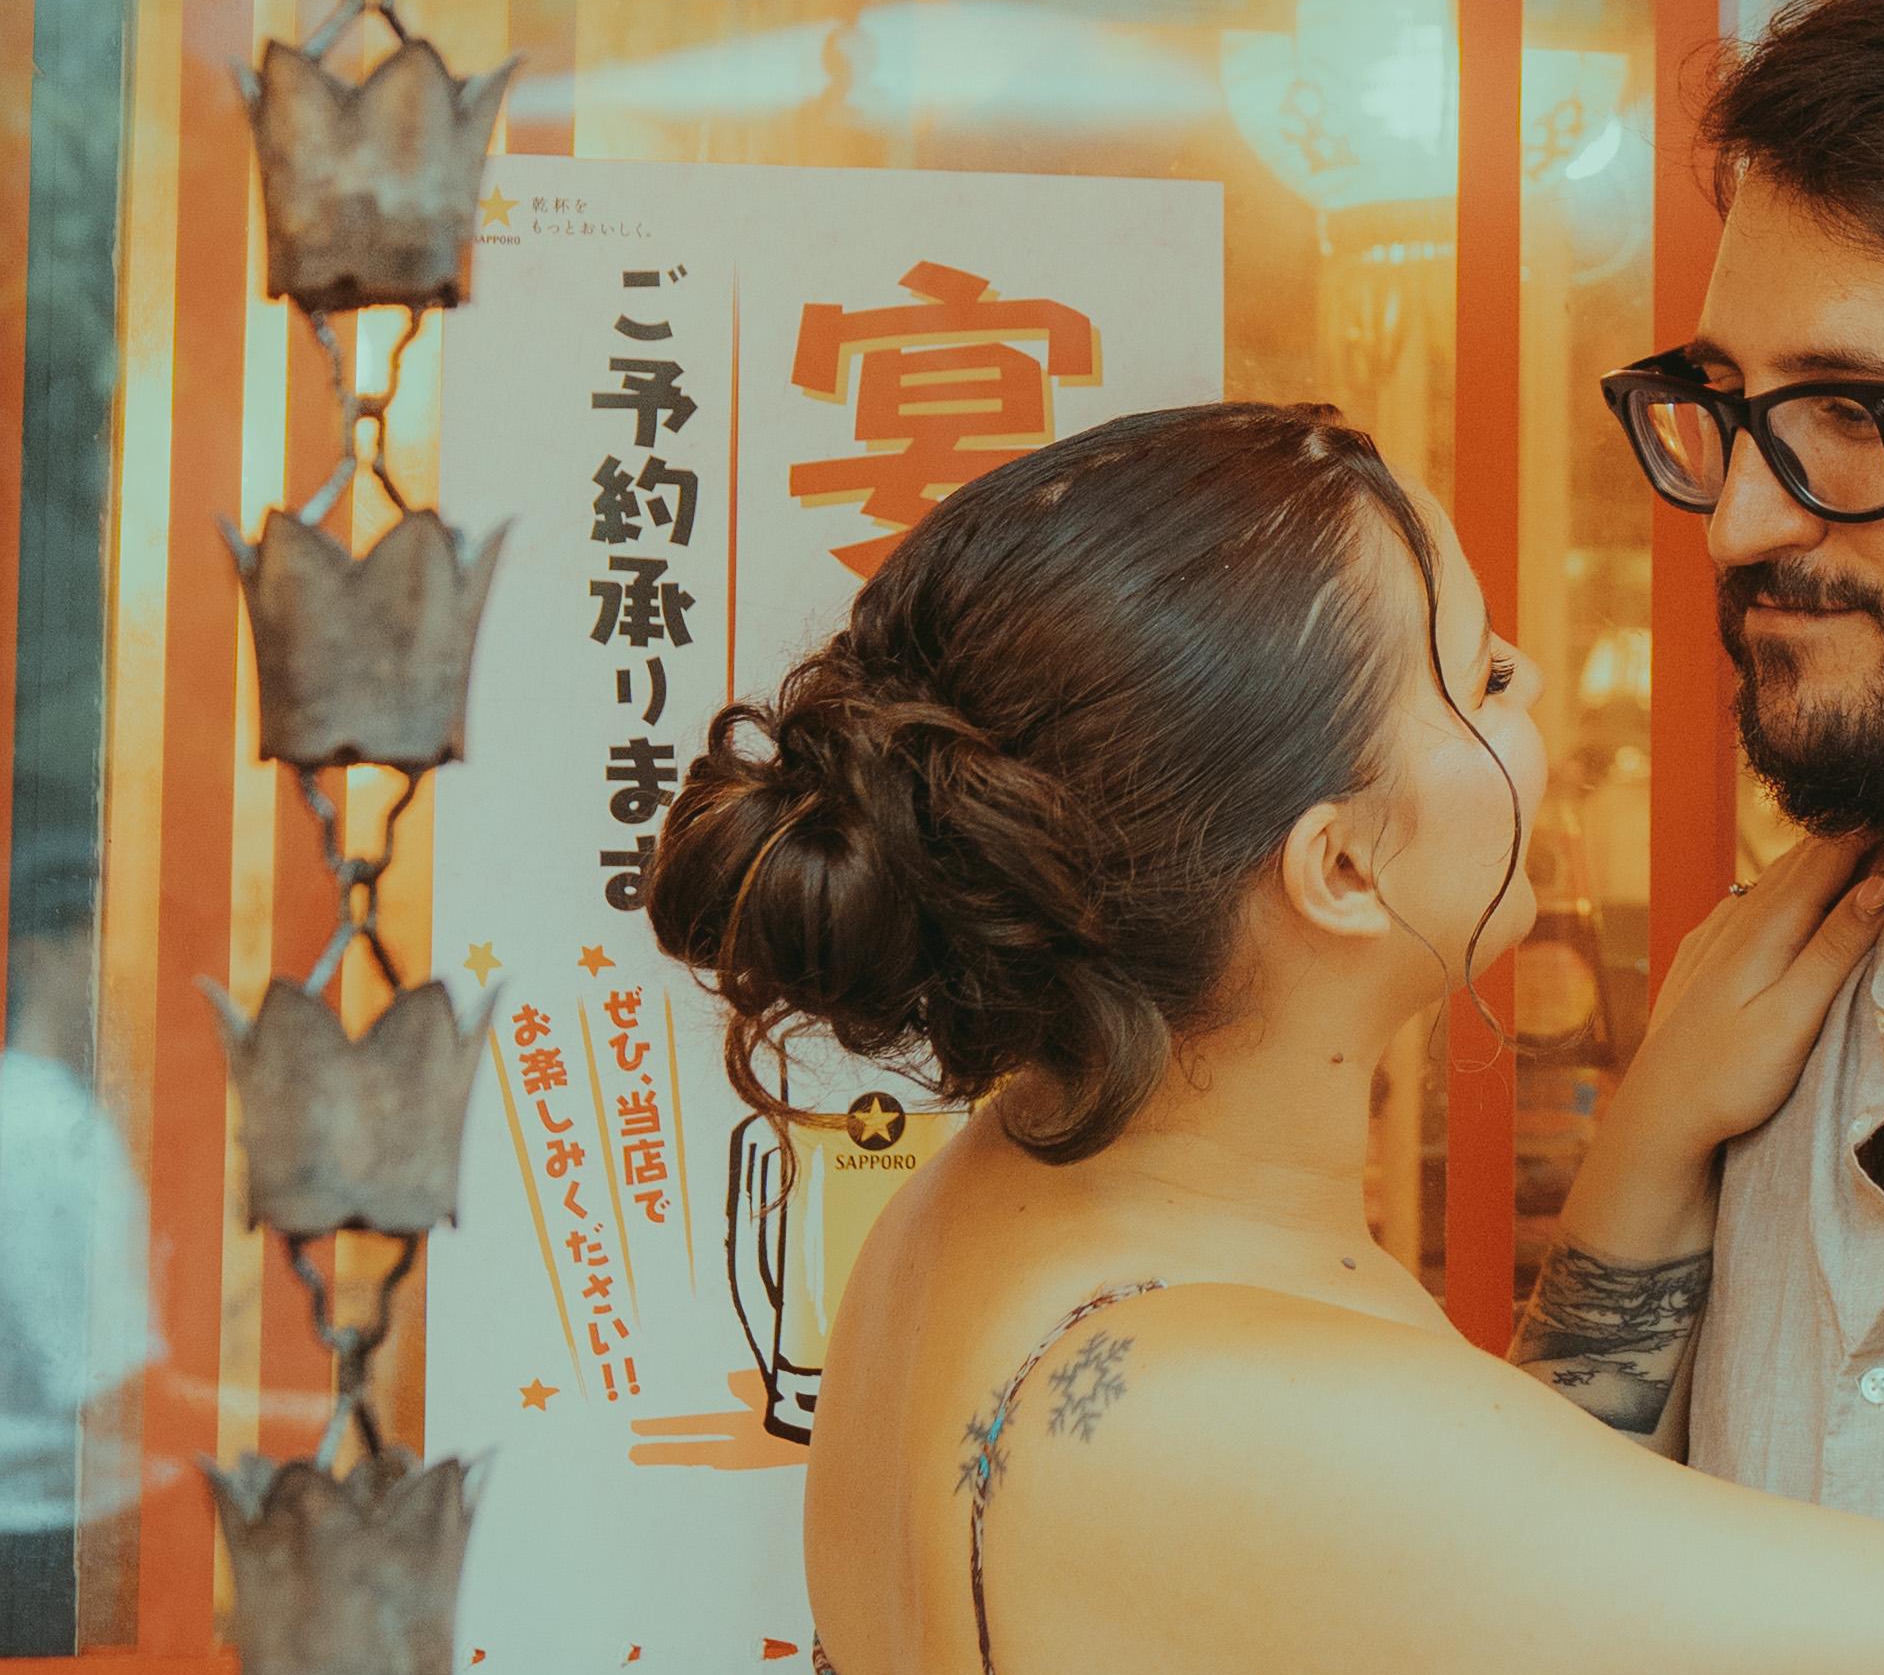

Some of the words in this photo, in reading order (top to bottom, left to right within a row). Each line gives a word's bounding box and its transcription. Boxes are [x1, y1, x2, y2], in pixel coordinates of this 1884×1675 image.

[531, 197, 588, 214] 乾杯を
[531, 219, 652, 239] もっとおいしく。
[603, 985, 671, 1224] ぜひ、当店で
[835, 1154, 916, 1171] SAPPORO
